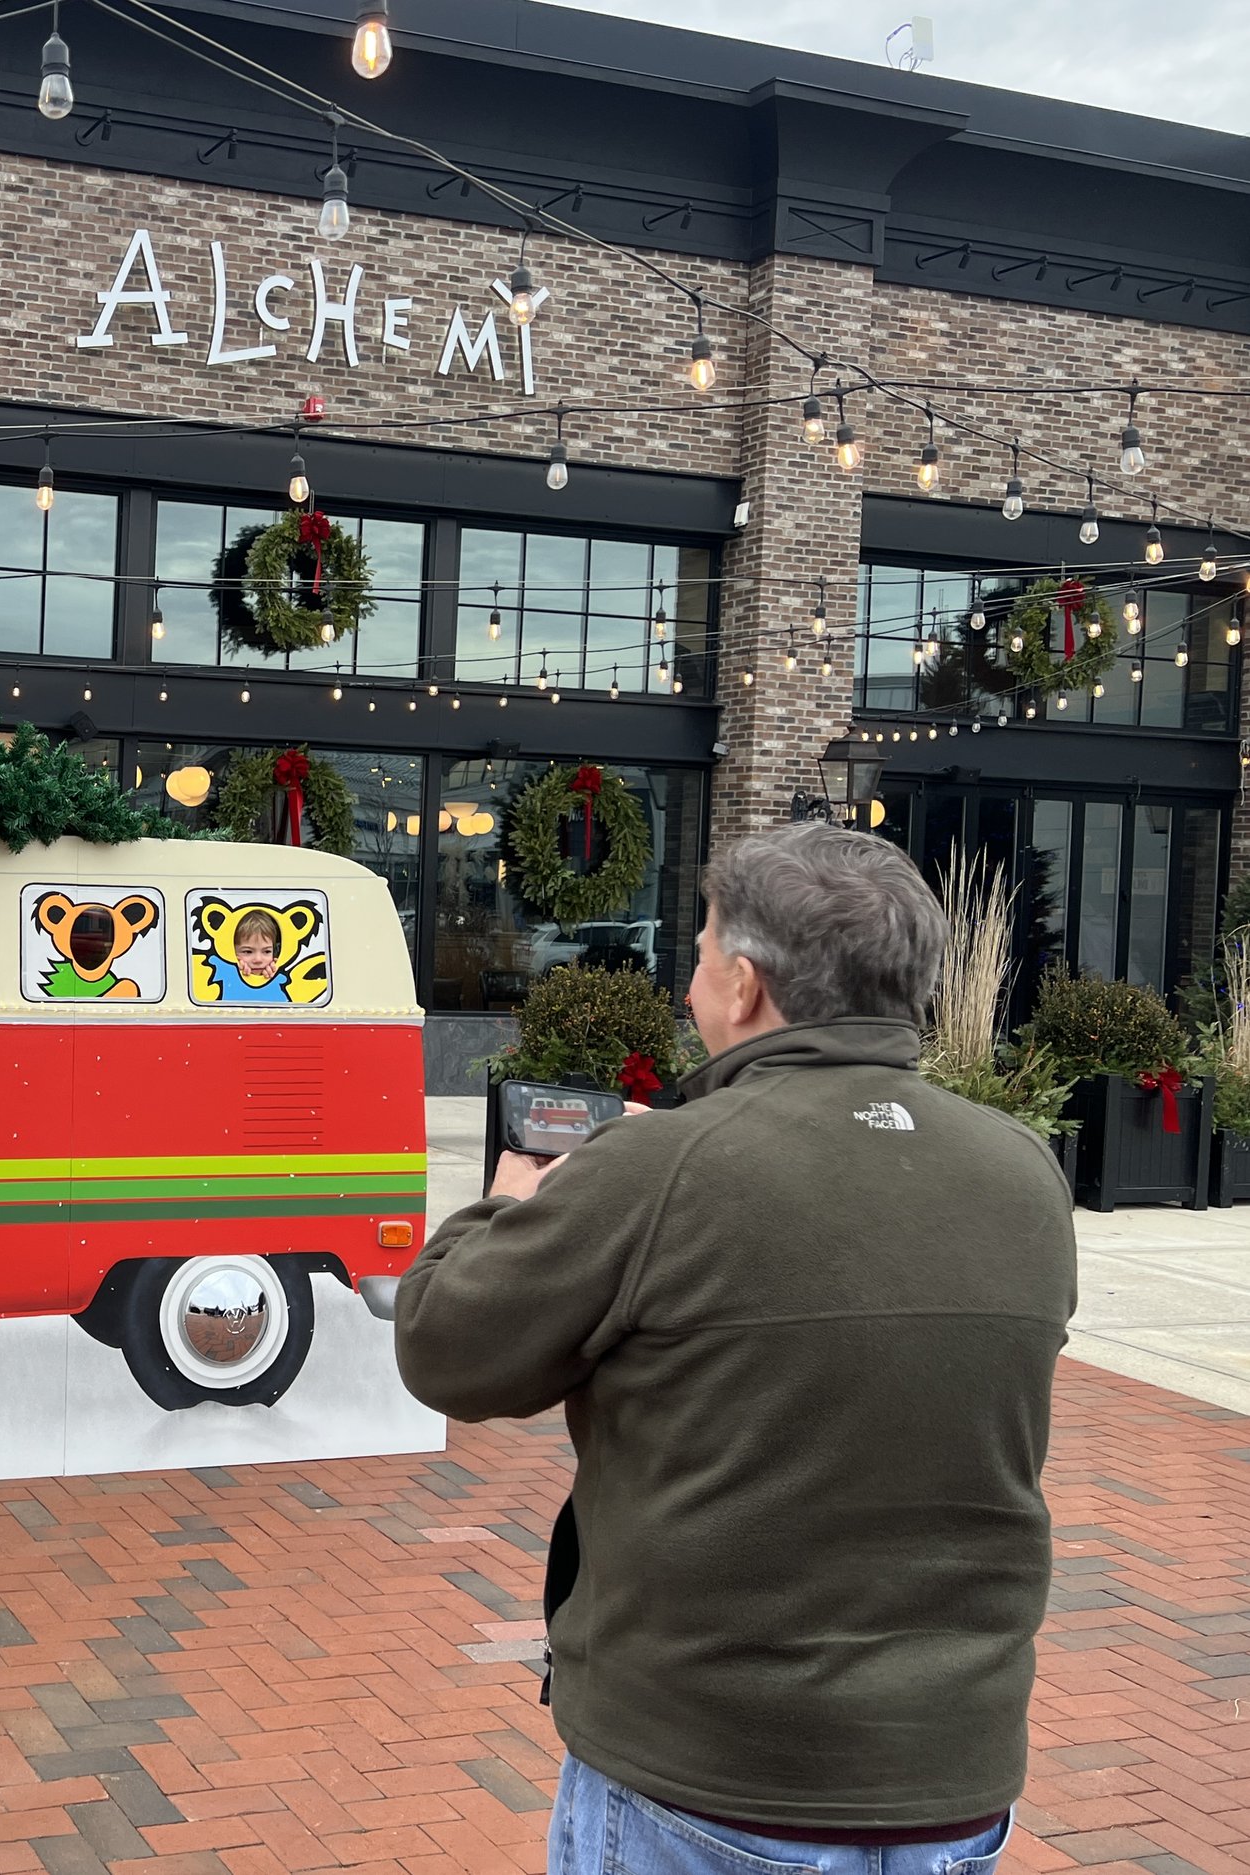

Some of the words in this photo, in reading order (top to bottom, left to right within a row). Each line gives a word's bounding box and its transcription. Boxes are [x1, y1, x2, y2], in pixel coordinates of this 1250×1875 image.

[76, 229, 551, 396] ALCHEMY
[868, 1102, 891, 1112] THE
[853, 1111, 894, 1121] NORTH
[868, 1120, 896, 1130] FACE
